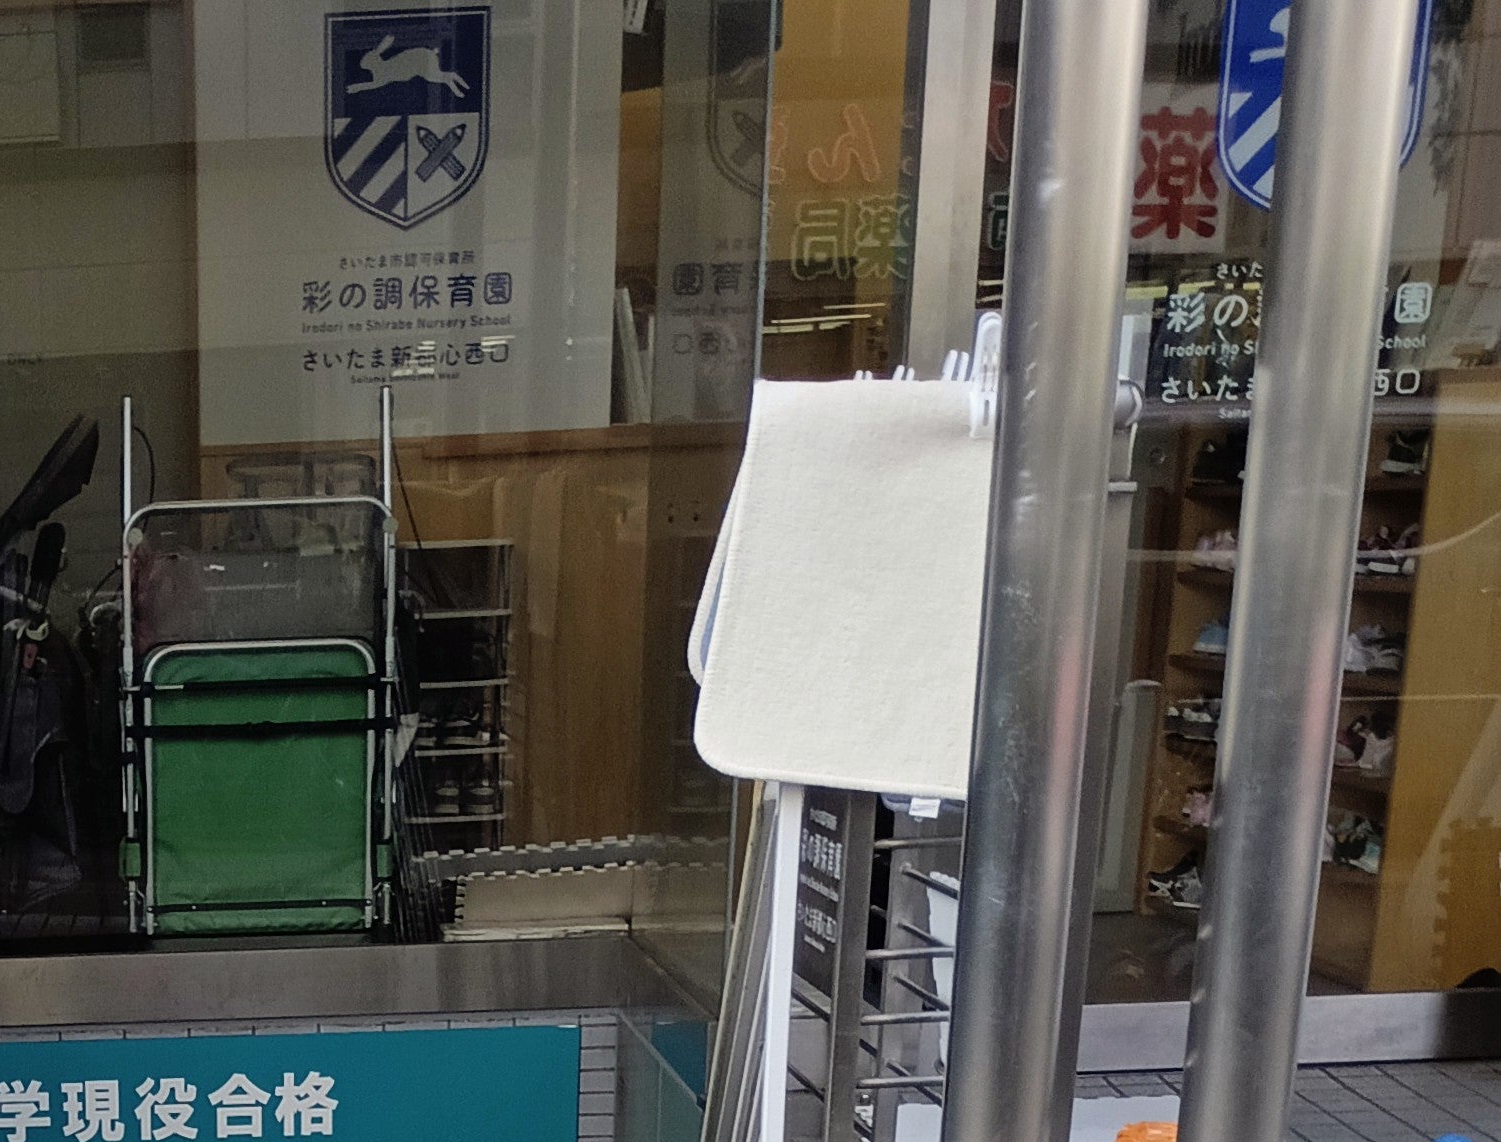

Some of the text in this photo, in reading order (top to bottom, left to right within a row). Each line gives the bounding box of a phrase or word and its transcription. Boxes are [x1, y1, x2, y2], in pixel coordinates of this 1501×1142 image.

[1131, 106, 1219, 239] 薬
[1217, 261, 1263, 279] さいた
[302, 272, 513, 314] 彩の調保育園
[417, 317, 466, 330] Nursery
[470, 314, 512, 328] School
[1163, 342, 1216, 357] Irodori
